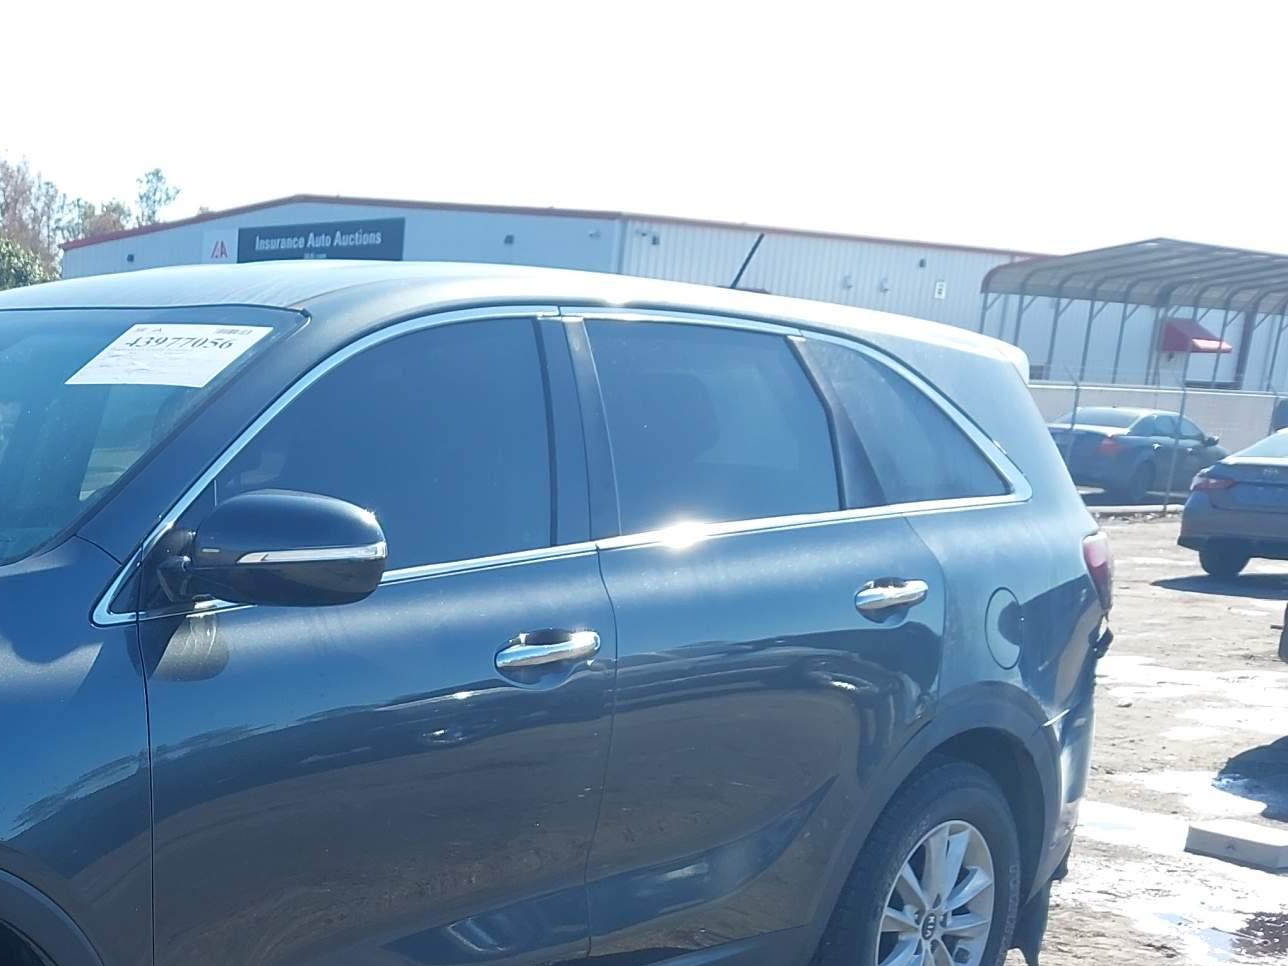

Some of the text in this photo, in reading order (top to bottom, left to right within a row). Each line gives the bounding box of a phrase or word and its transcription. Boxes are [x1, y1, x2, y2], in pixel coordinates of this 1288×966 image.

[255, 228, 382, 250] Insurance Auto Auctions
[125, 336, 233, 348] 43977056
